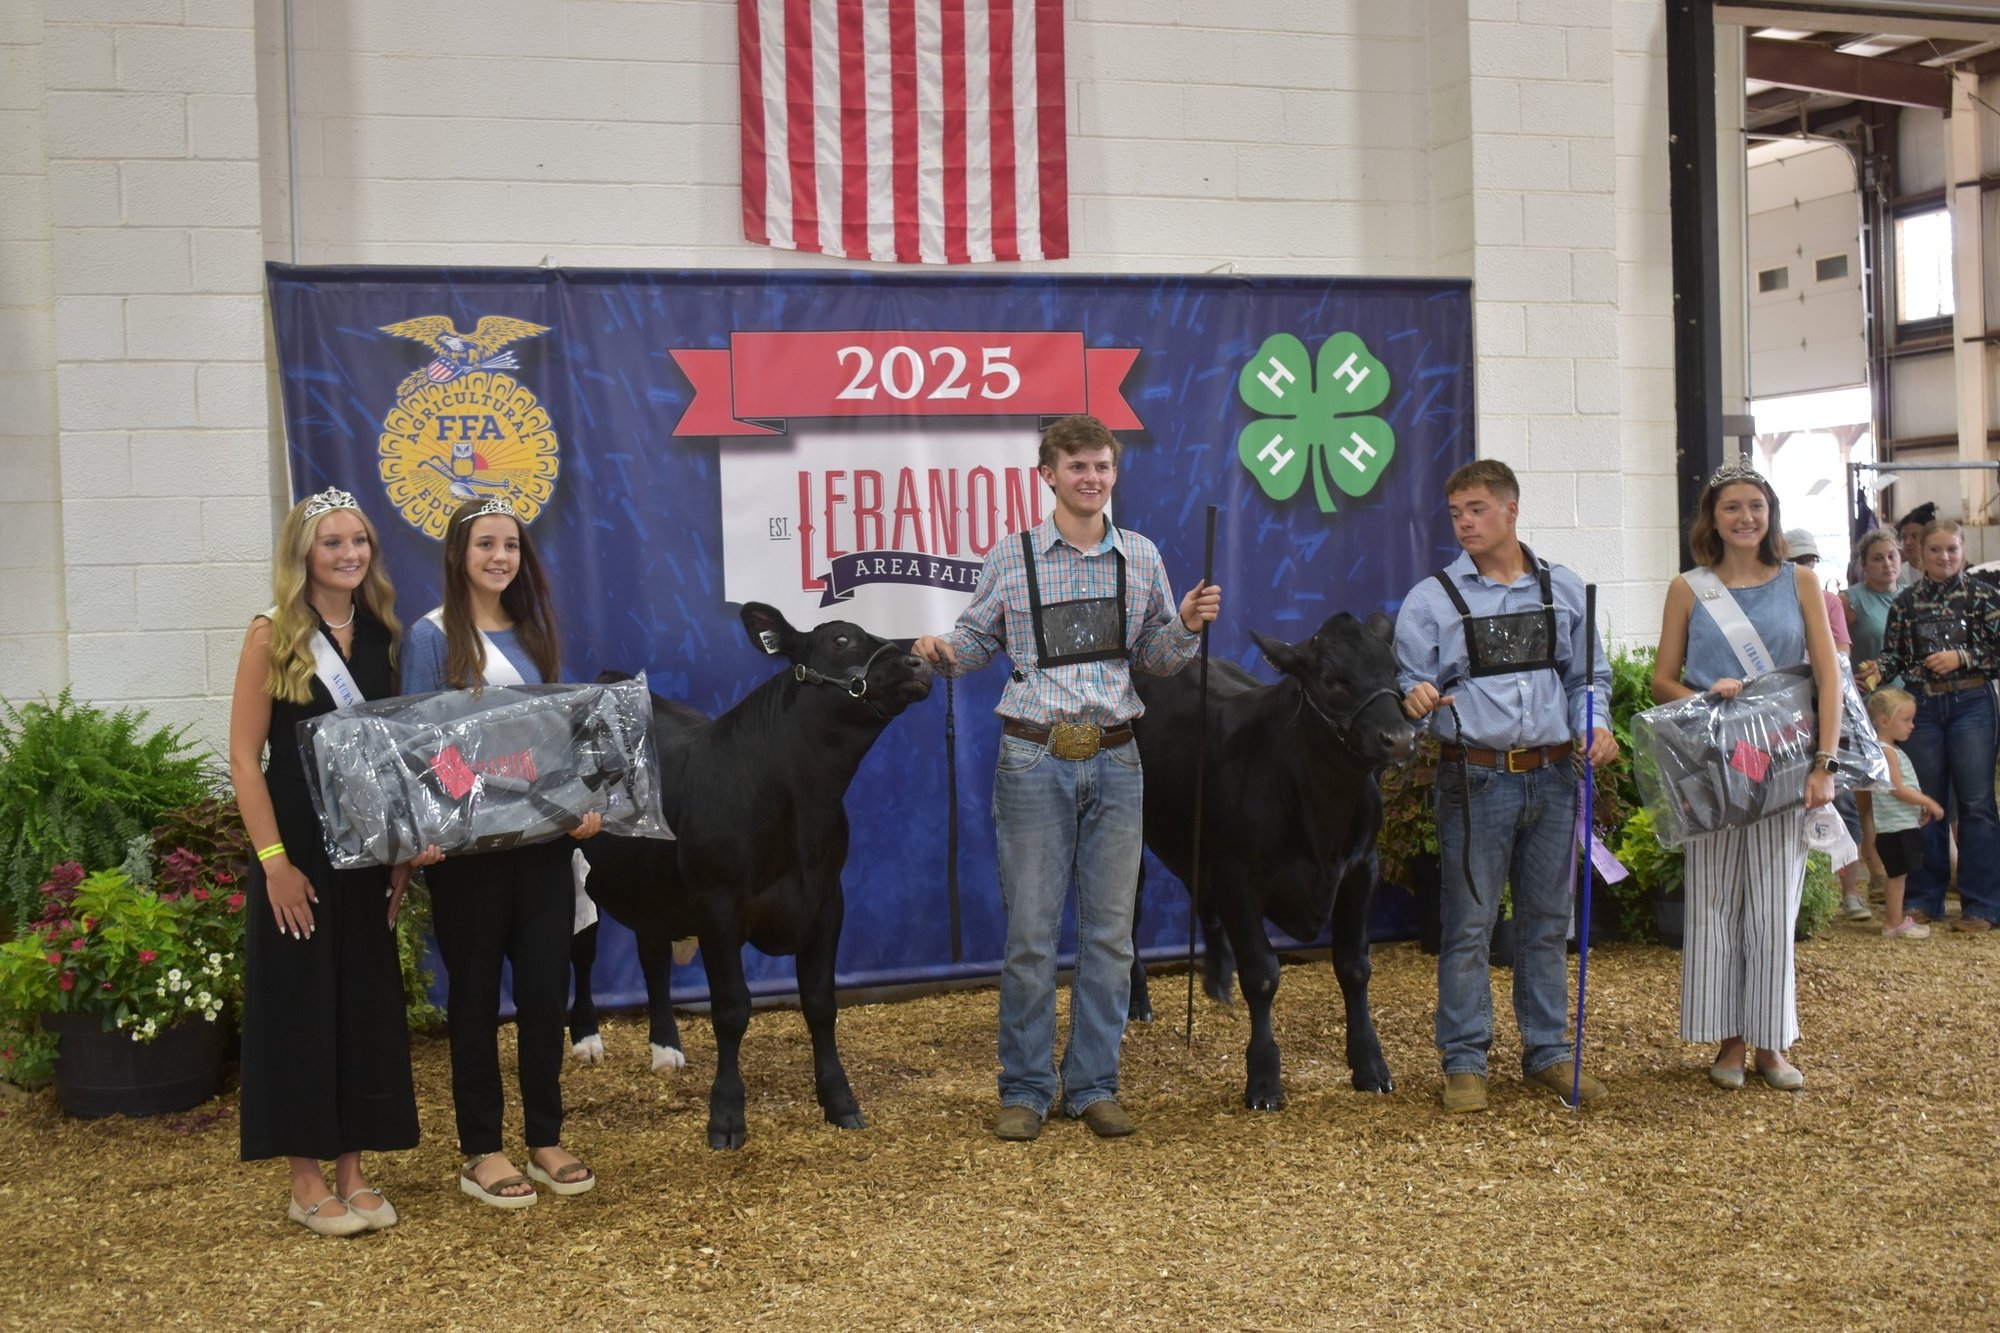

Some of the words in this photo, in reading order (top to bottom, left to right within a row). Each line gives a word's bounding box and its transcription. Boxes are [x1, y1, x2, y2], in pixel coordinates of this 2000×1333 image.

[835, 344, 1021, 401] 2025
[1256, 356, 1296, 399] H
[1332, 352, 1371, 394] H
[405, 391, 534, 446] AGRICULTURAL
[435, 414, 506, 441] FFA
[1256, 433, 1296, 476] H
[1338, 431, 1377, 473] H
[417, 485, 523, 517] EDUON
[769, 517, 792, 537] EST.
[797, 465, 1044, 592] LEBANON
[855, 558, 922, 577] AREA
[928, 562, 982, 585] FAIR
